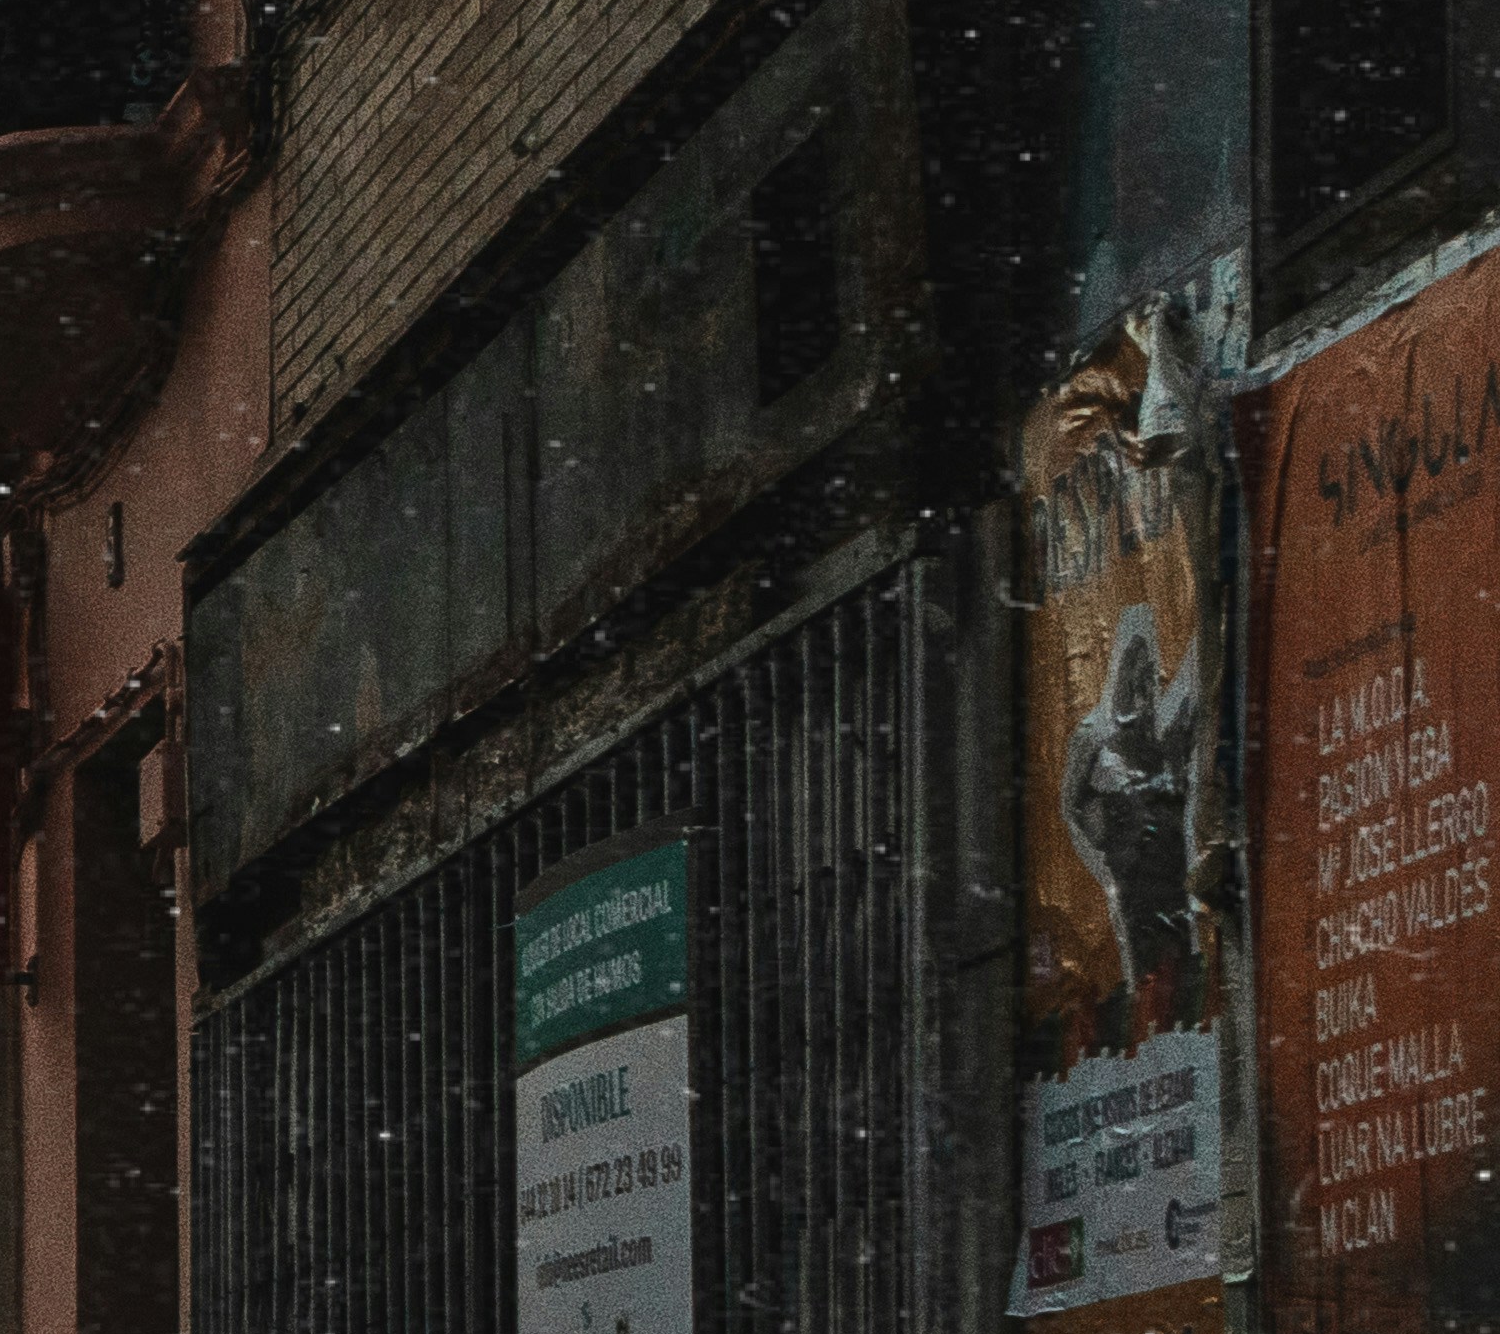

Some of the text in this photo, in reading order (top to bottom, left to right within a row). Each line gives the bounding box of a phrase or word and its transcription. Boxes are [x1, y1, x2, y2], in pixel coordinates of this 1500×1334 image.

[1402, 780, 1489, 864] LLERGO
[1316, 891, 1400, 970] CHUCHO
[1316, 973, 1378, 1042] BUIKA
[541, 1066, 631, 1143] DISPONIBLE
[1317, 1020, 1466, 1112] COQUE MALLA
[1318, 1088, 1487, 1185] LUAR NA LUBRE
